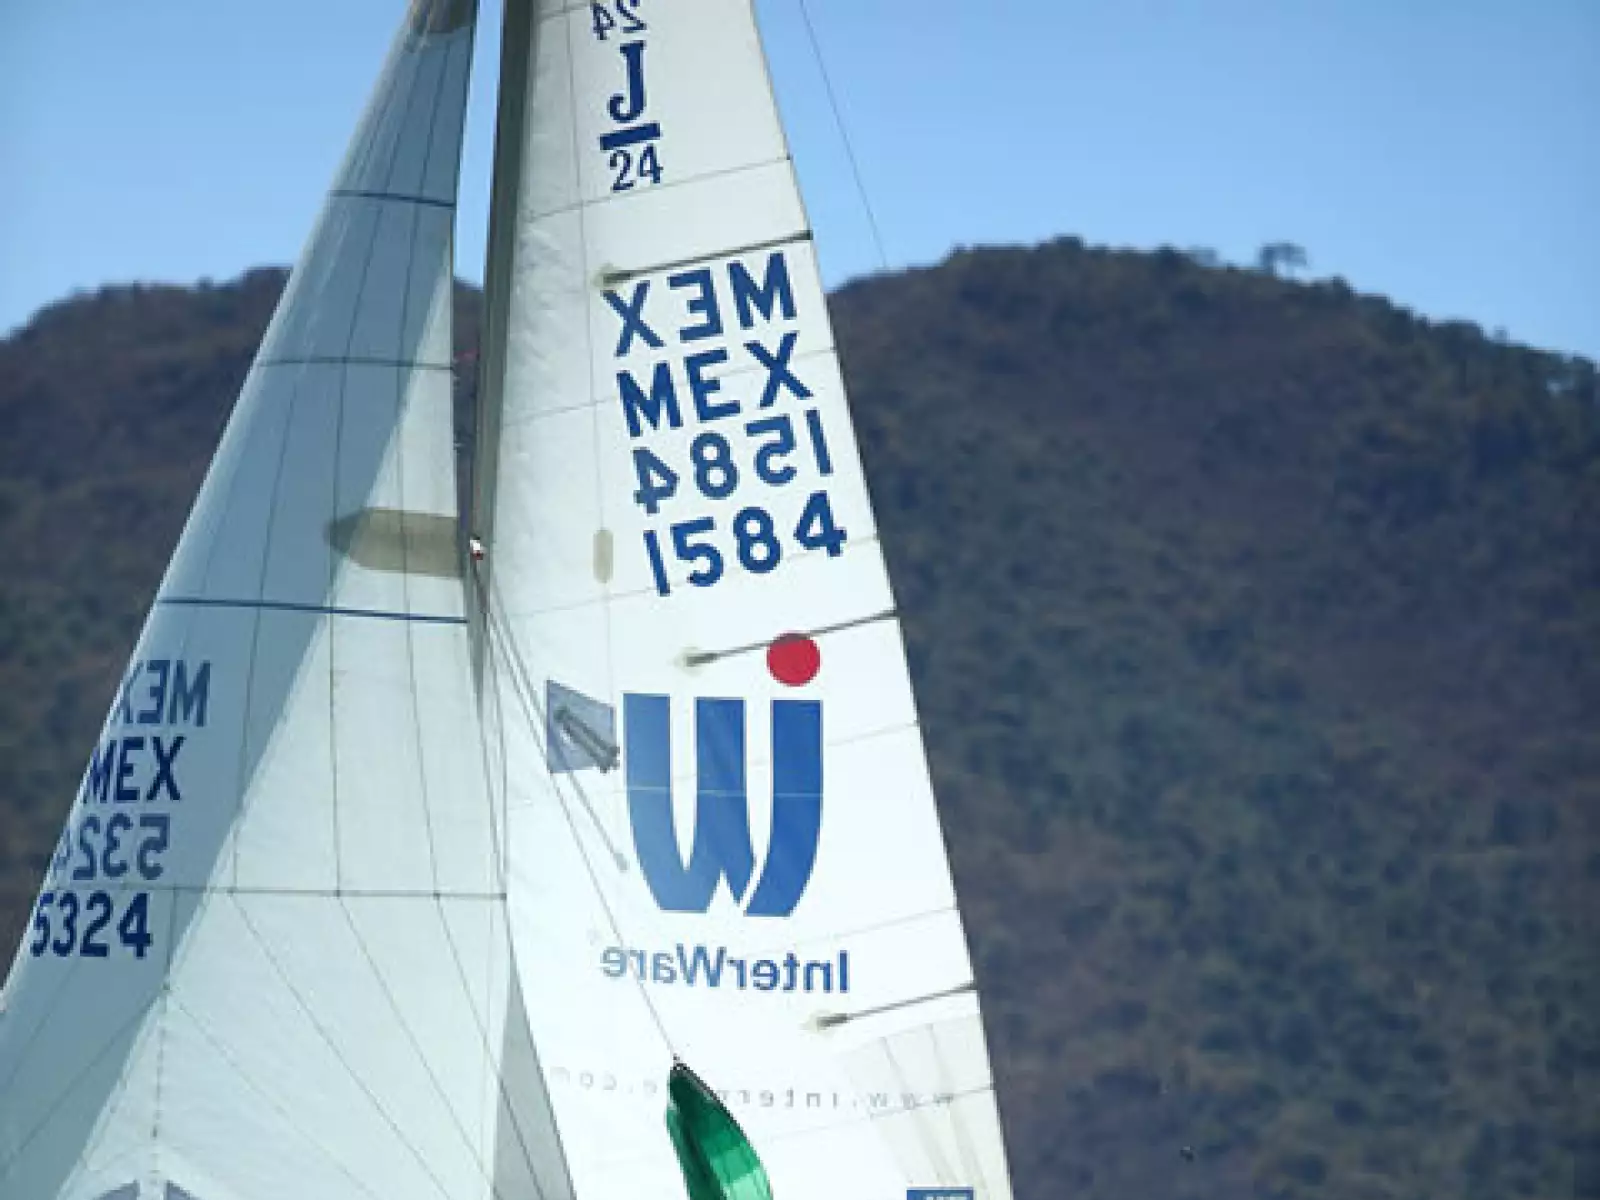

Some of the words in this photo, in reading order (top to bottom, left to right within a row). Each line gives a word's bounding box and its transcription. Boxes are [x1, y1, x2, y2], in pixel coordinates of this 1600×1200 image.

[608, 41, 647, 123] J
[609, 145, 664, 192] 24
[616, 330, 814, 438] MEX
[643, 490, 847, 598] 1584
